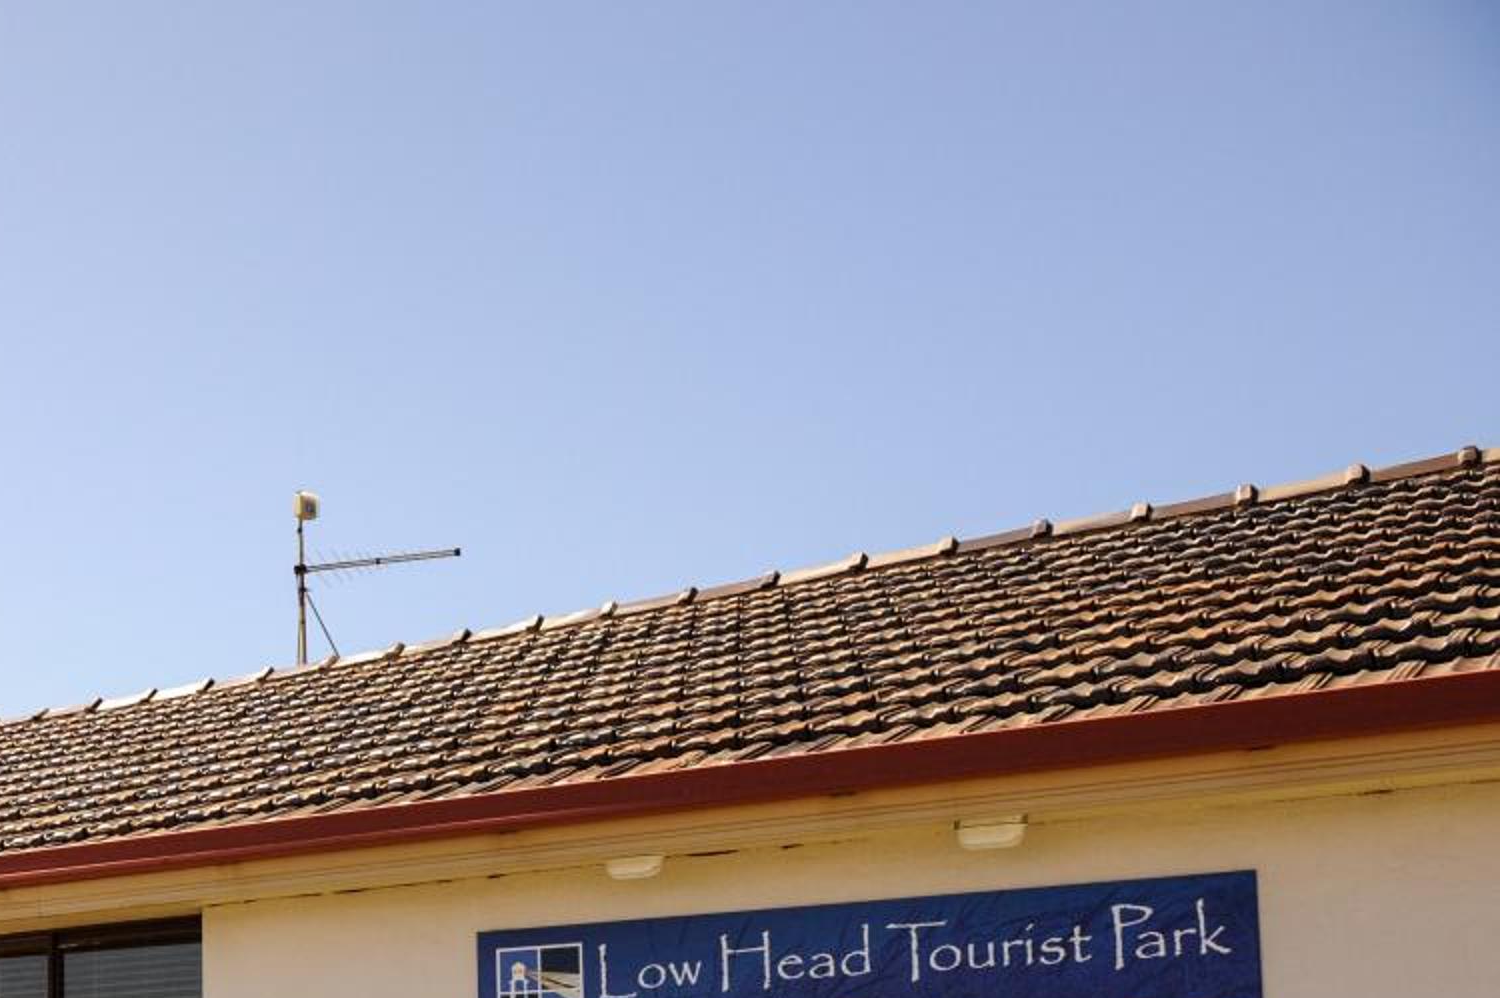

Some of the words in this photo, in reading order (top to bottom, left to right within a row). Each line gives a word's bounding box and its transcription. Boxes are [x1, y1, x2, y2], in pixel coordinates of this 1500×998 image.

[720, 922, 872, 994] Head
[885, 920, 1093, 984] Tourist
[1111, 898, 1233, 971] Park
